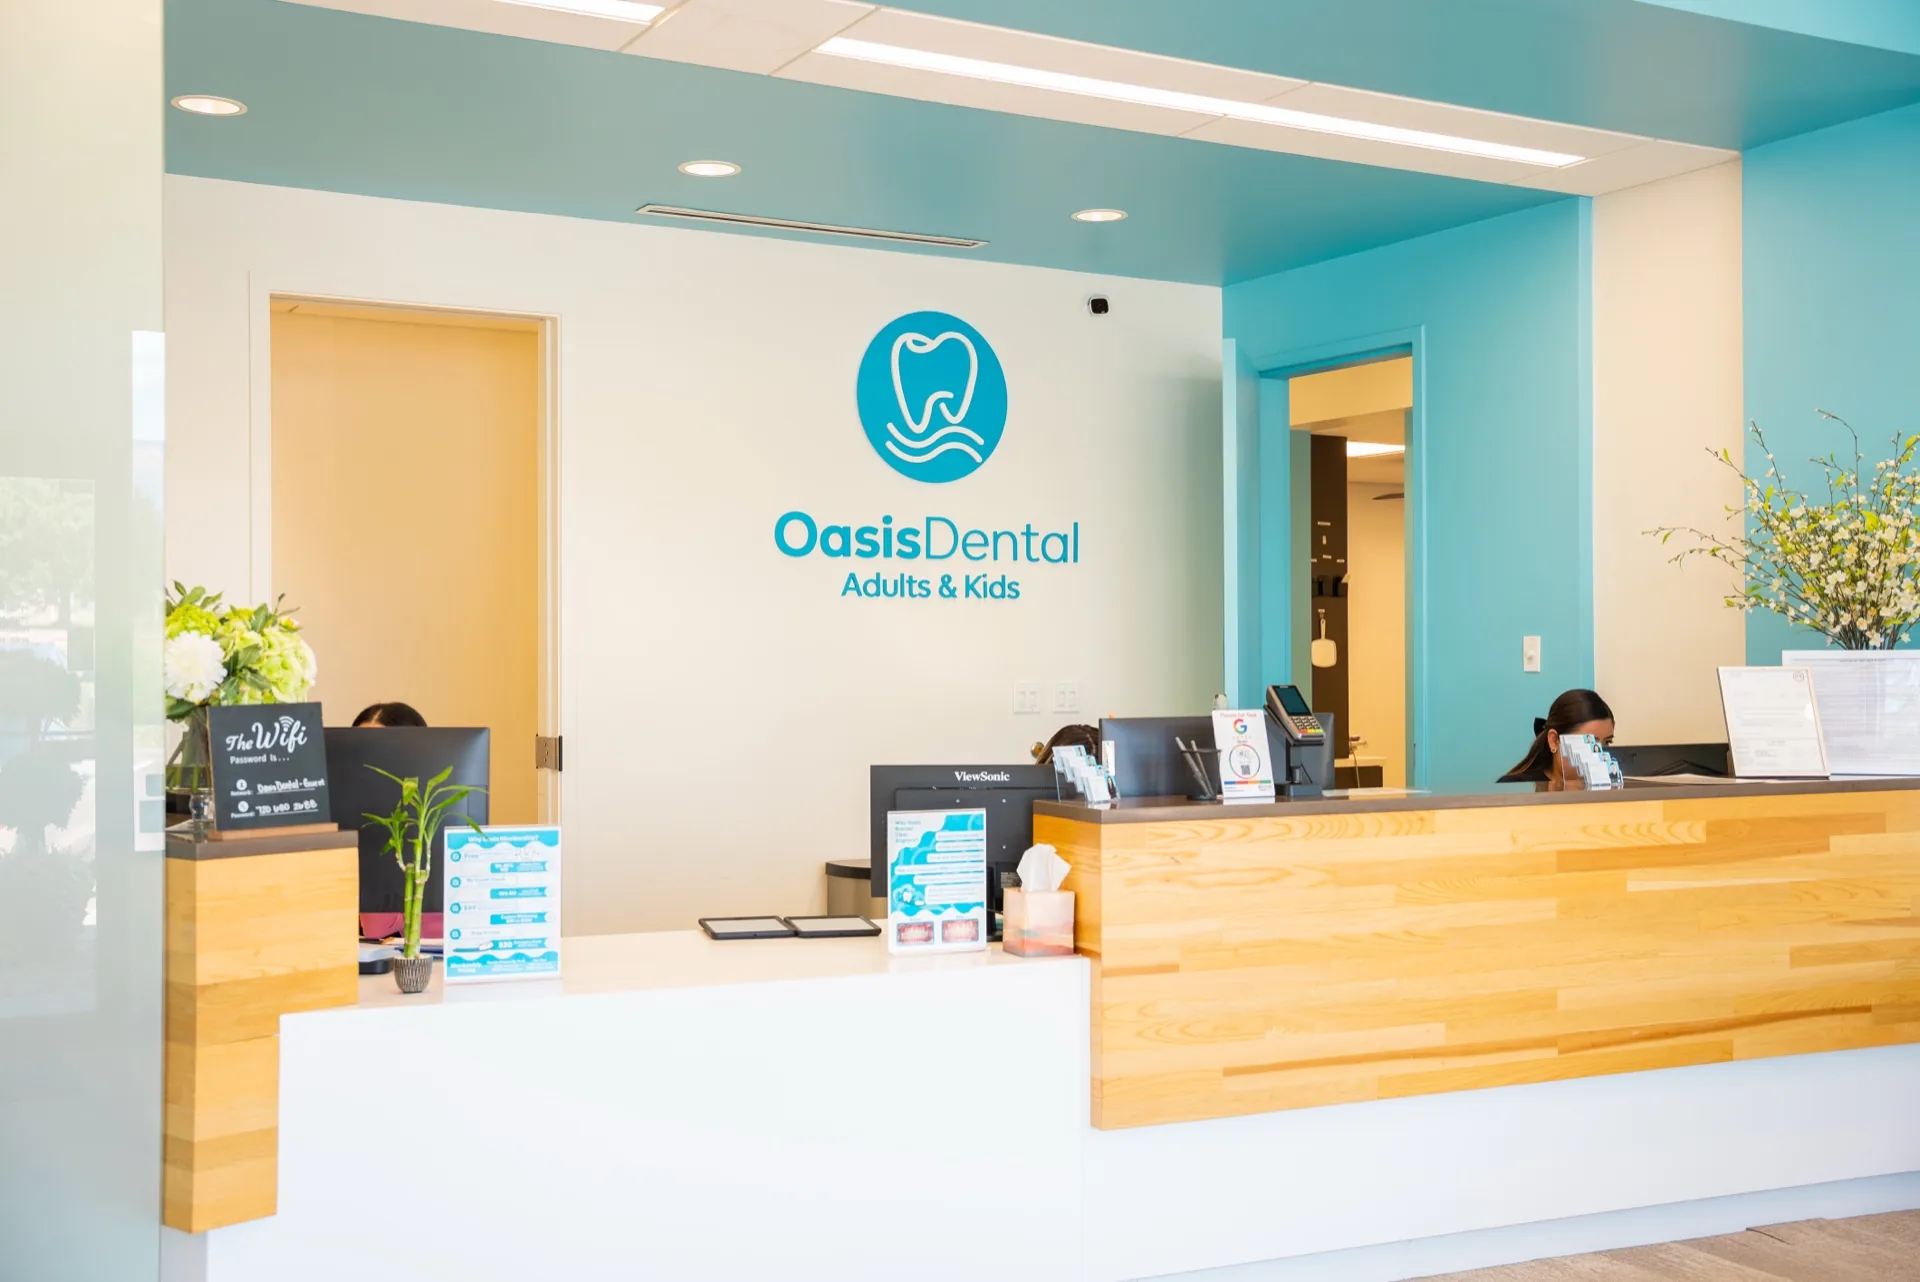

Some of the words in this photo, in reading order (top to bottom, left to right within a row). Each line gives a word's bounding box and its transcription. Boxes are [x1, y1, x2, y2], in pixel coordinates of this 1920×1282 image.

[774, 510, 1079, 564] OasisDental
[841, 572, 931, 598] Adults
[938, 573, 957, 599] &
[964, 573, 1021, 600] Kids
[225, 733, 253, 751] The
[252, 718, 307, 753] Wifi
[230, 754, 267, 764] Password
[954, 771, 1010, 782] ViewSonic
